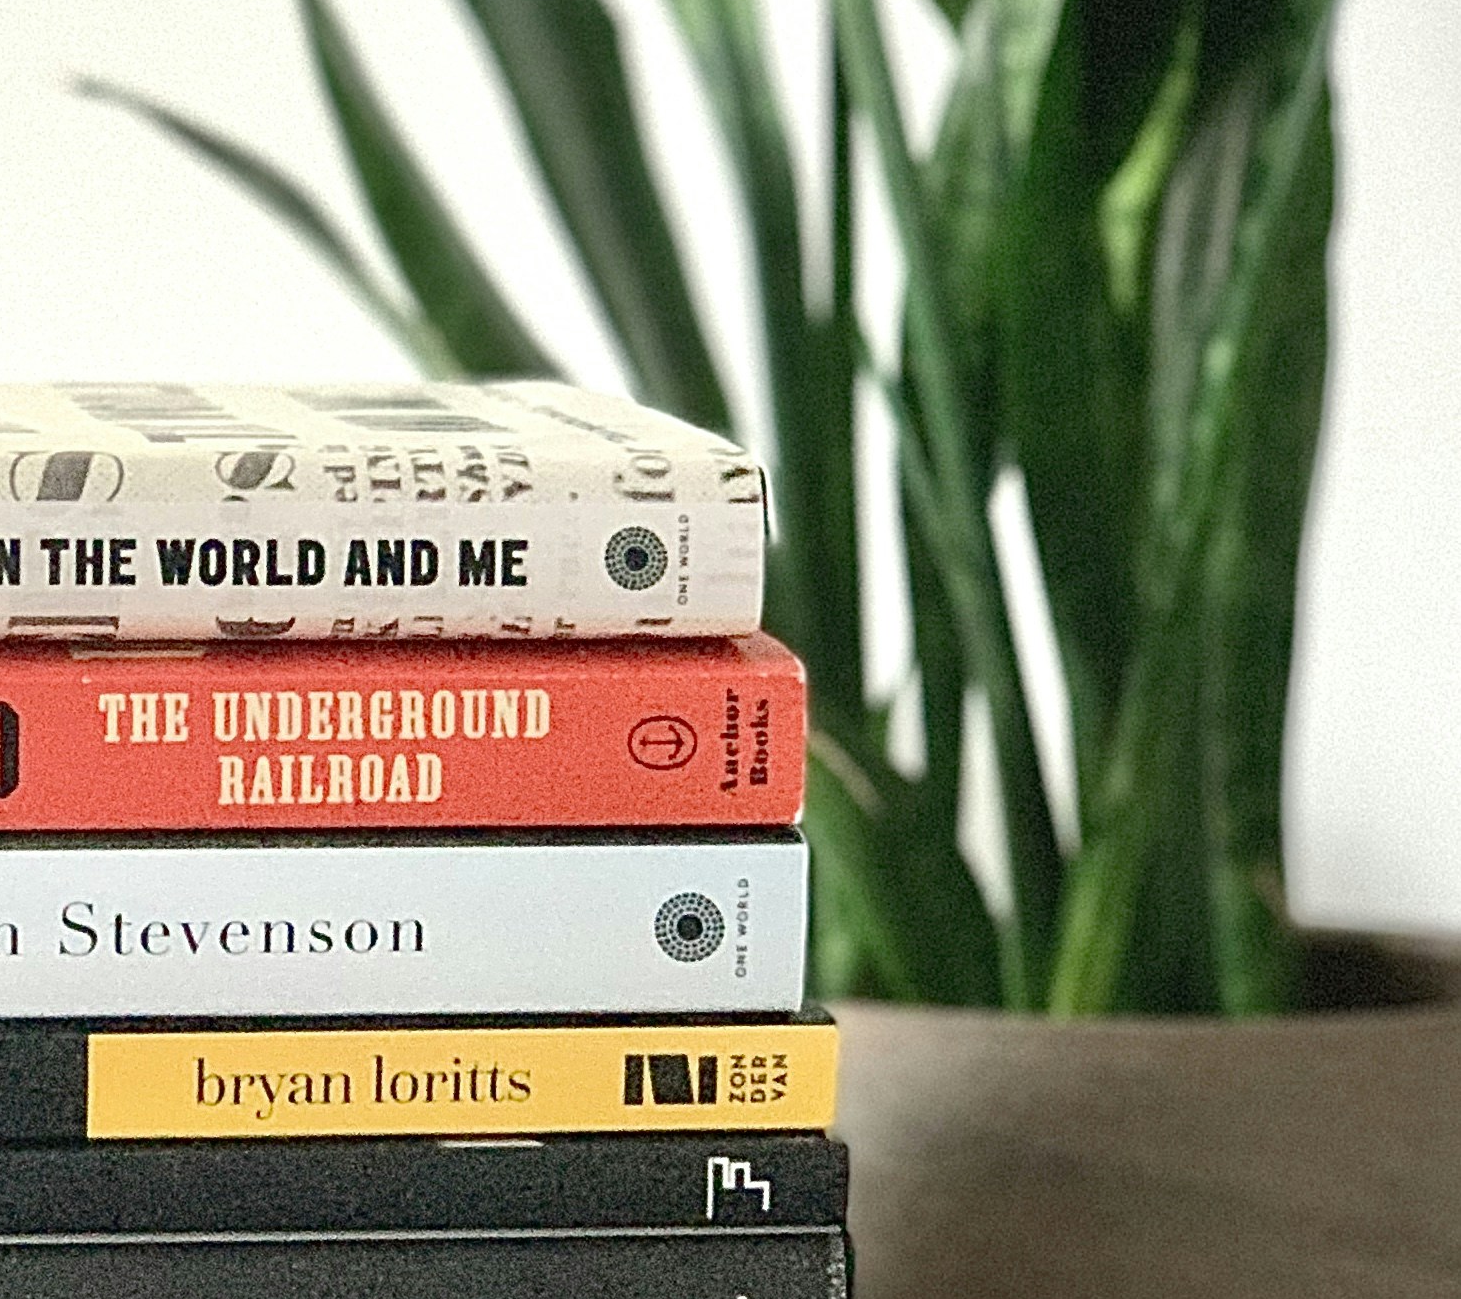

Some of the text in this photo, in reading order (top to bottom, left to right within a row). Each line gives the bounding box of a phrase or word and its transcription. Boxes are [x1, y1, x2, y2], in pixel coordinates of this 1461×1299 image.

[40, 538, 137, 586] THE
[156, 538, 326, 587] WORLD
[343, 539, 439, 587] AND
[458, 539, 529, 587] ME
[677, 514, 689, 606] ONE WORLD
[98, 689, 550, 743] THE UNDERGROUND
[719, 688, 740, 792] Anchor
[749, 698, 769, 786] Books
[218, 753, 442, 805] RAILROAD
[57, 901, 428, 958] Stevenson
[734, 878, 750, 979] ONE WORLD
[193, 1055, 532, 1120] bryan loritts
